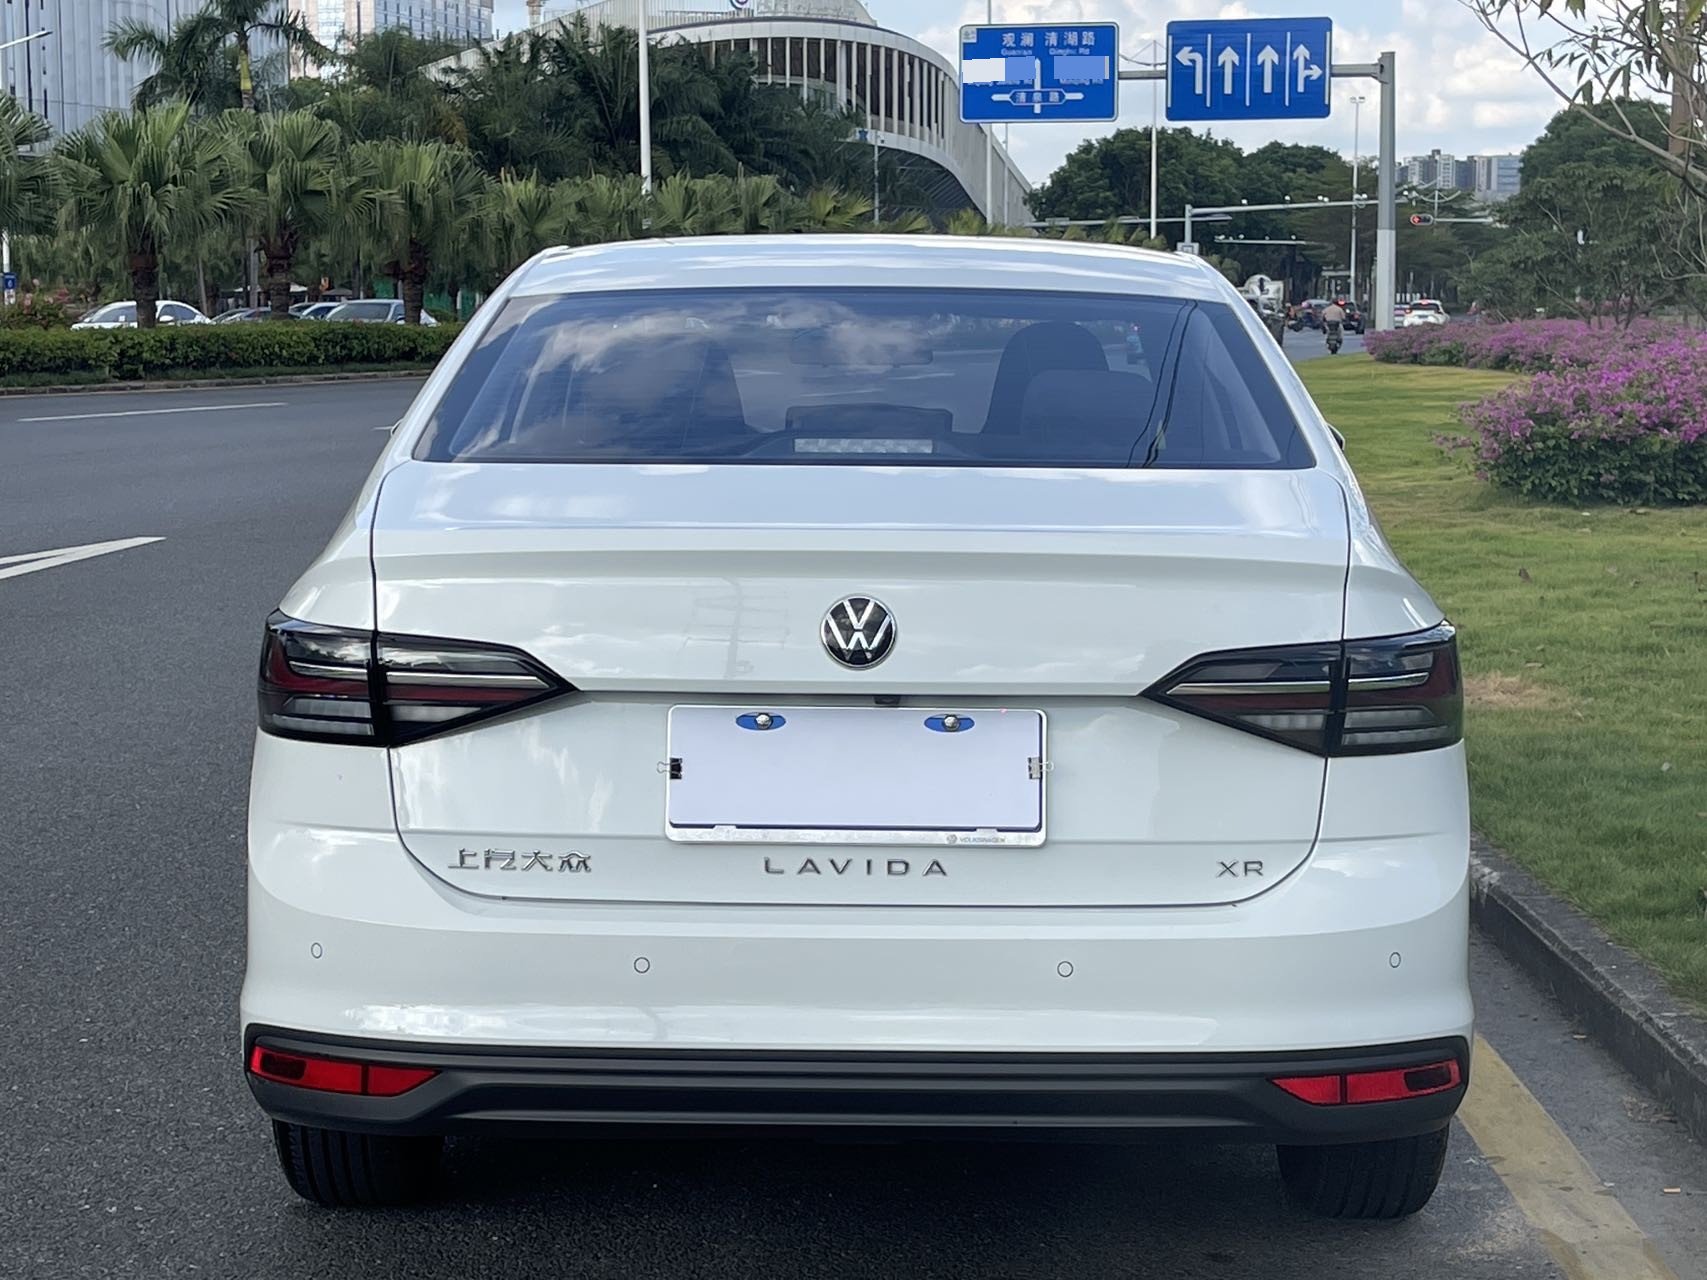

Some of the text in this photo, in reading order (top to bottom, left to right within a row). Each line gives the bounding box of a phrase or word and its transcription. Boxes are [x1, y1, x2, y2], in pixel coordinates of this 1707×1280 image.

[1002, 31, 1095, 47] 观澜 清湖路
[448, 848, 592, 873] 上汽大众
[763, 856, 948, 877] LAVIDA
[1216, 860, 1264, 878] XR
